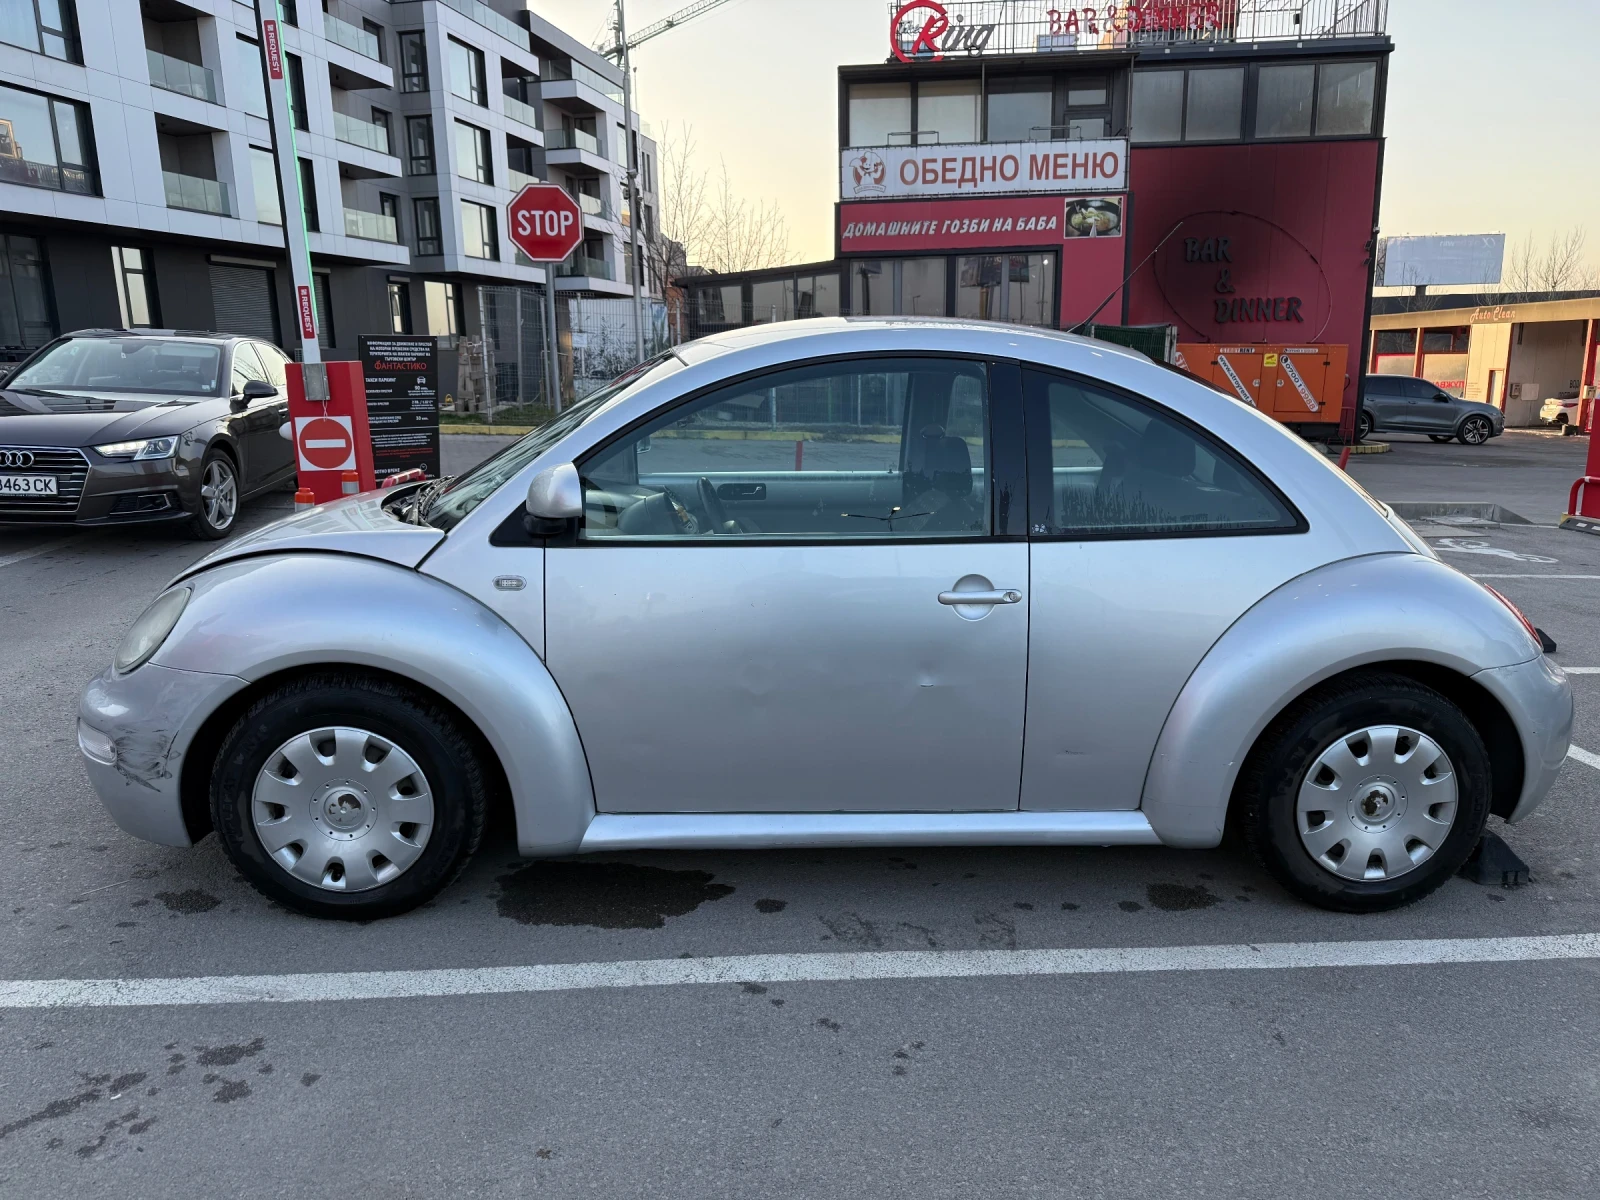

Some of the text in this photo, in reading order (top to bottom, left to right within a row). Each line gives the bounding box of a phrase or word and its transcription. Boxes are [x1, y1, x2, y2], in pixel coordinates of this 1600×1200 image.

[1047, 1, 1222, 35] BAR & DINNER
[911, 14, 996, 58] Ring
[268, 32, 280, 72] REQUEST
[900, 151, 1119, 189] ОБЕДНО МЕНЮ
[517, 210, 574, 236] STOP
[842, 215, 1057, 239] ДОМАШНИТЕ ГОЗБИ НА БАБА
[1184, 236, 1233, 263] BAR
[1216, 267, 1236, 293] &
[301, 296, 313, 333] REQUEST
[1215, 297, 1304, 323] DINNER
[1470, 306, 1516, 323] Auto Clean
[374, 361, 427, 370] ФАНТАСТИКО
[1219, 355, 1254, 405] www.stroyrent.b
[1285, 363, 1300, 383] 0700
[1300, 388, 1316, 410] 9988
[34, 478, 54, 492] CK
